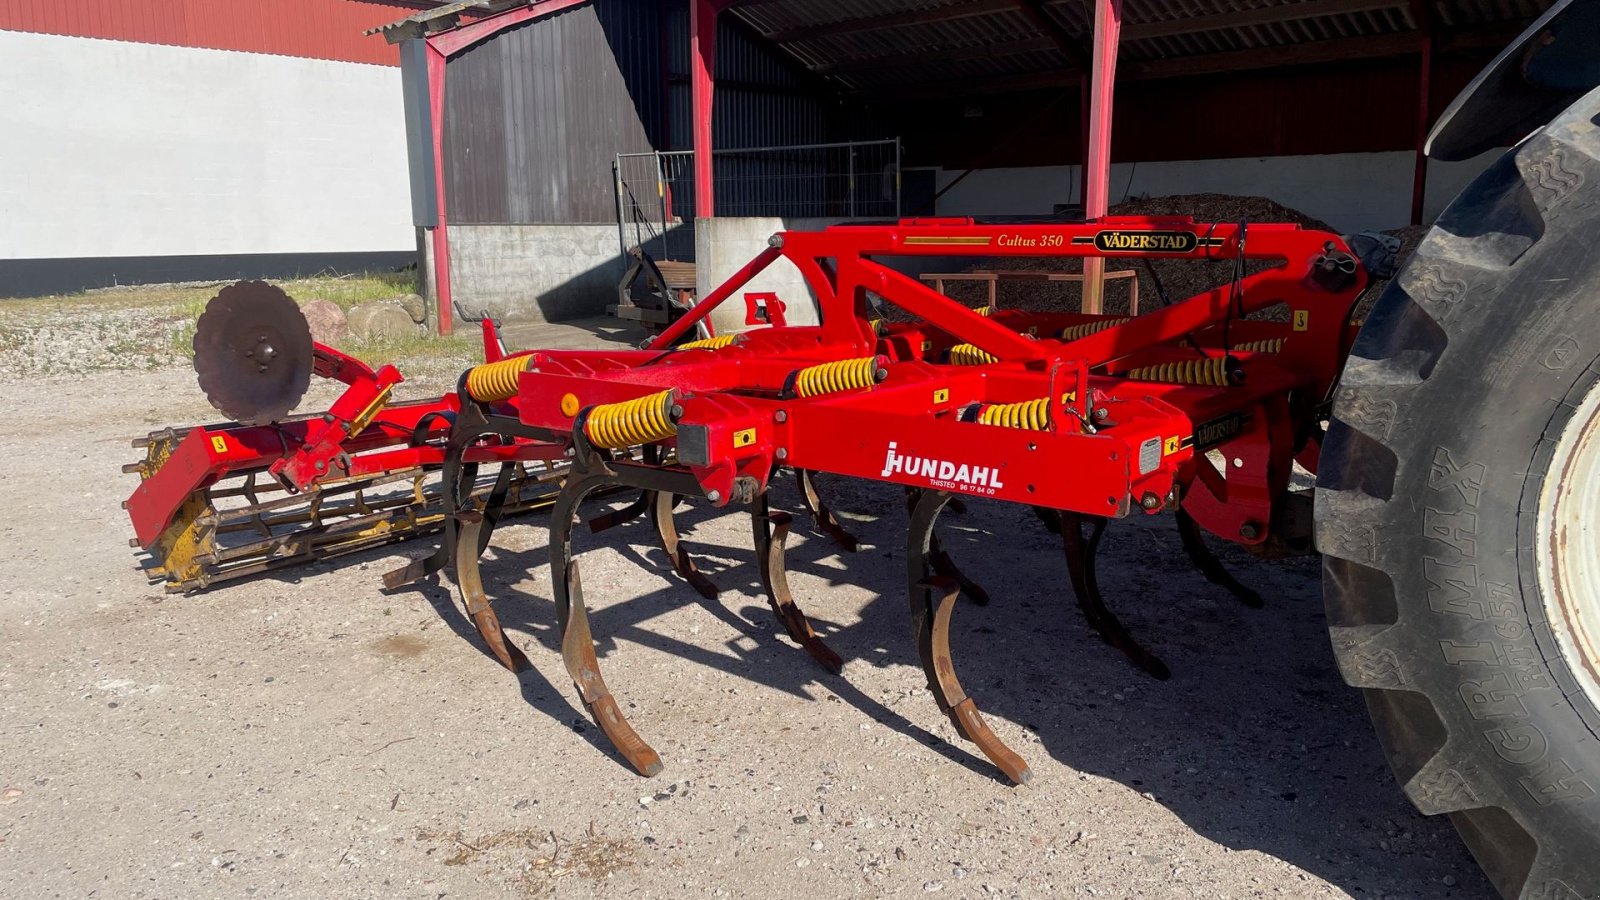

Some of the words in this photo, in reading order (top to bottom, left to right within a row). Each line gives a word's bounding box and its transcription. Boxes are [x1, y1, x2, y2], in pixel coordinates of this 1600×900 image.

[997, 233, 1036, 247] Cultus
[1040, 234, 1063, 247] 350
[1102, 232, 1187, 249] VÄDERSTAD
[929, 479, 956, 489] THISTED
[1504, 645, 1548, 689] RT
